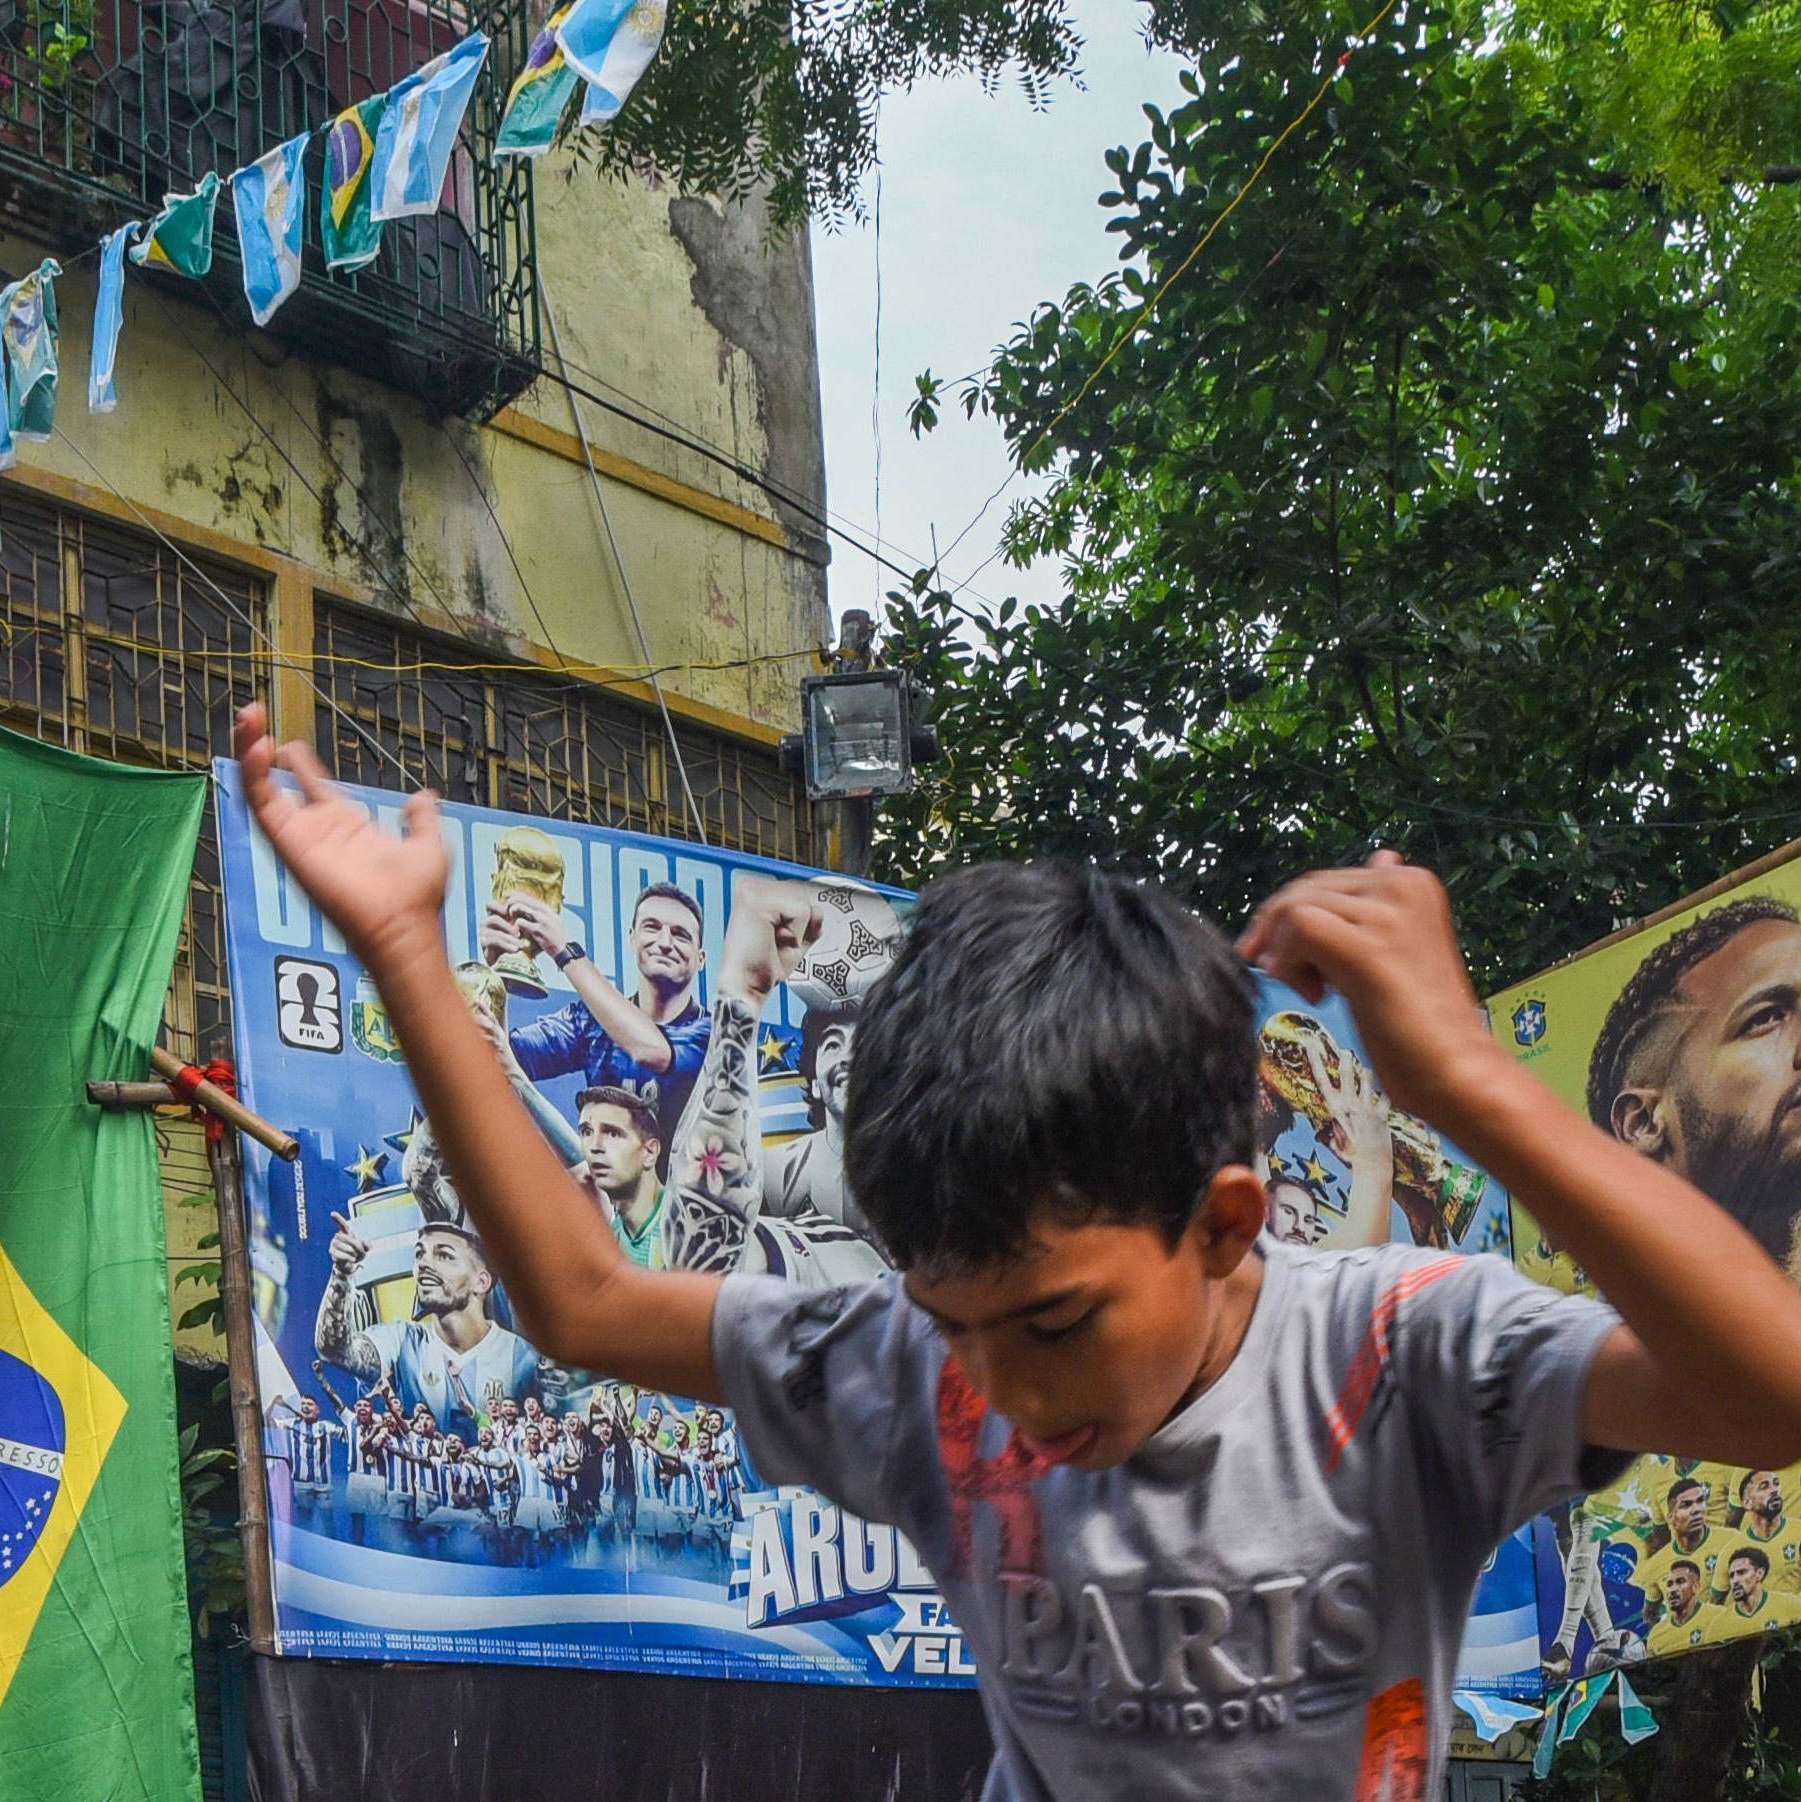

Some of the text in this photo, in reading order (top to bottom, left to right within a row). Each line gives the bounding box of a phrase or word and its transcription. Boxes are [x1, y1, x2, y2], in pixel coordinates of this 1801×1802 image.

[299, 1028, 325, 1041] FIFA
[999, 1561, 1379, 1693] PARIS
[1091, 1694, 1288, 1732] LONDON
